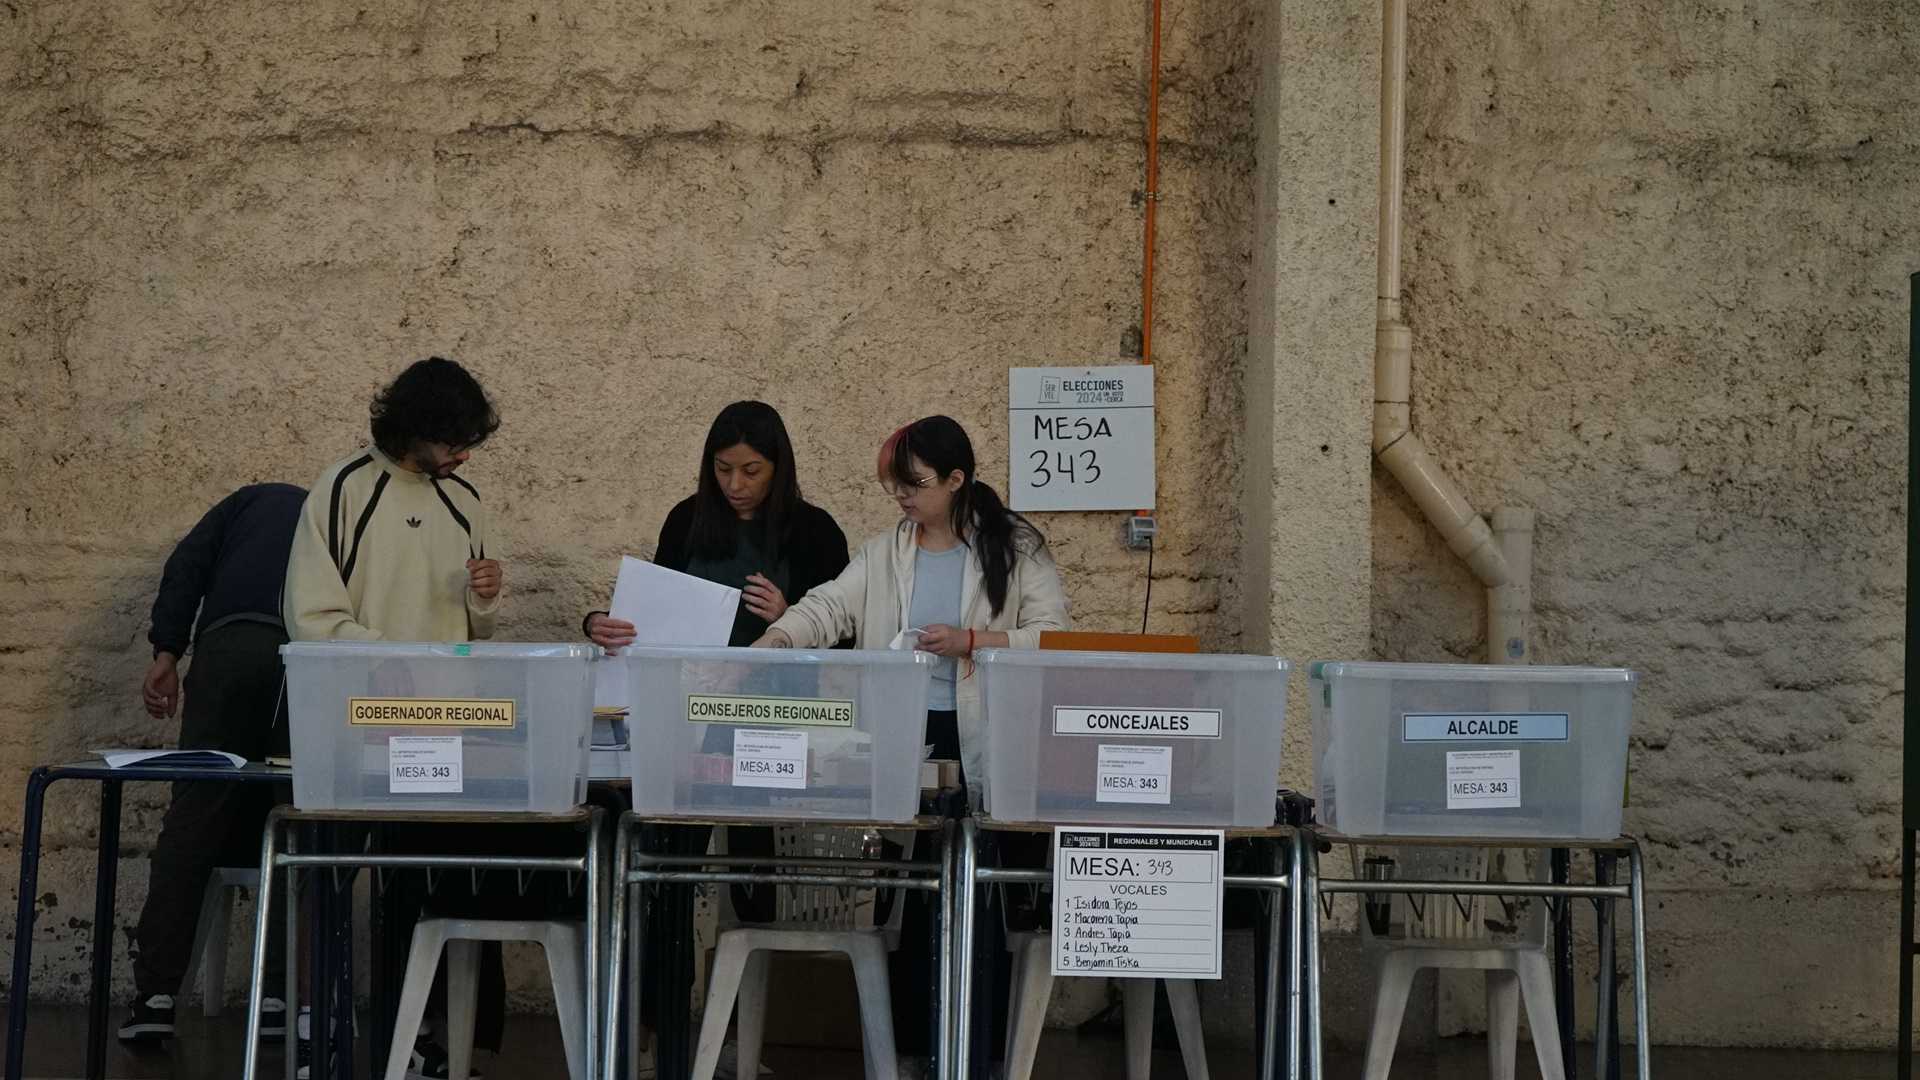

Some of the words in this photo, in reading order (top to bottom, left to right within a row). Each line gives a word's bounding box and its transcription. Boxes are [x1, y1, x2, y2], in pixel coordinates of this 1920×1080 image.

[1063, 380, 1124, 392] ELECCIONES
[1076, 392, 1102, 403] 2024
[1034, 414, 1112, 440] MESA
[1030, 450, 1100, 488] 343
[355, 706, 442, 720] GOBERNADOR
[446, 707, 508, 721] REGIONAL
[691, 702, 770, 718] CONSEJEROS
[774, 706, 850, 721] REGIONALES
[1086, 714, 1189, 731] CONCEJALES
[1447, 720, 1518, 735] ALCALDE
[396, 766, 429, 778] MESA:
[432, 767, 450, 778] 343
[740, 761, 773, 774] MESA:
[776, 763, 794, 774] 343
[1103, 777, 1137, 789] MESA:
[1140, 778, 1158, 789] 343
[1454, 783, 1488, 794] MESA:
[1490, 782, 1508, 793] 343
[1070, 857, 1140, 877] MESA:
[1148, 859, 1173, 876] 343
[1110, 885, 1168, 896] VOCALES
[1066, 898, 1070, 908] 1
[1074, 896, 1109, 909] Isidora
[1064, 913, 1071, 923] 2
[1115, 914, 1138, 929] Tapia
[1064, 927, 1070, 937] 3
[1107, 928, 1130, 942] Tapia
[1063, 942, 1070, 951] 4
[1075, 940, 1098, 957] Lesly
[1064, 956, 1070, 966] 5
